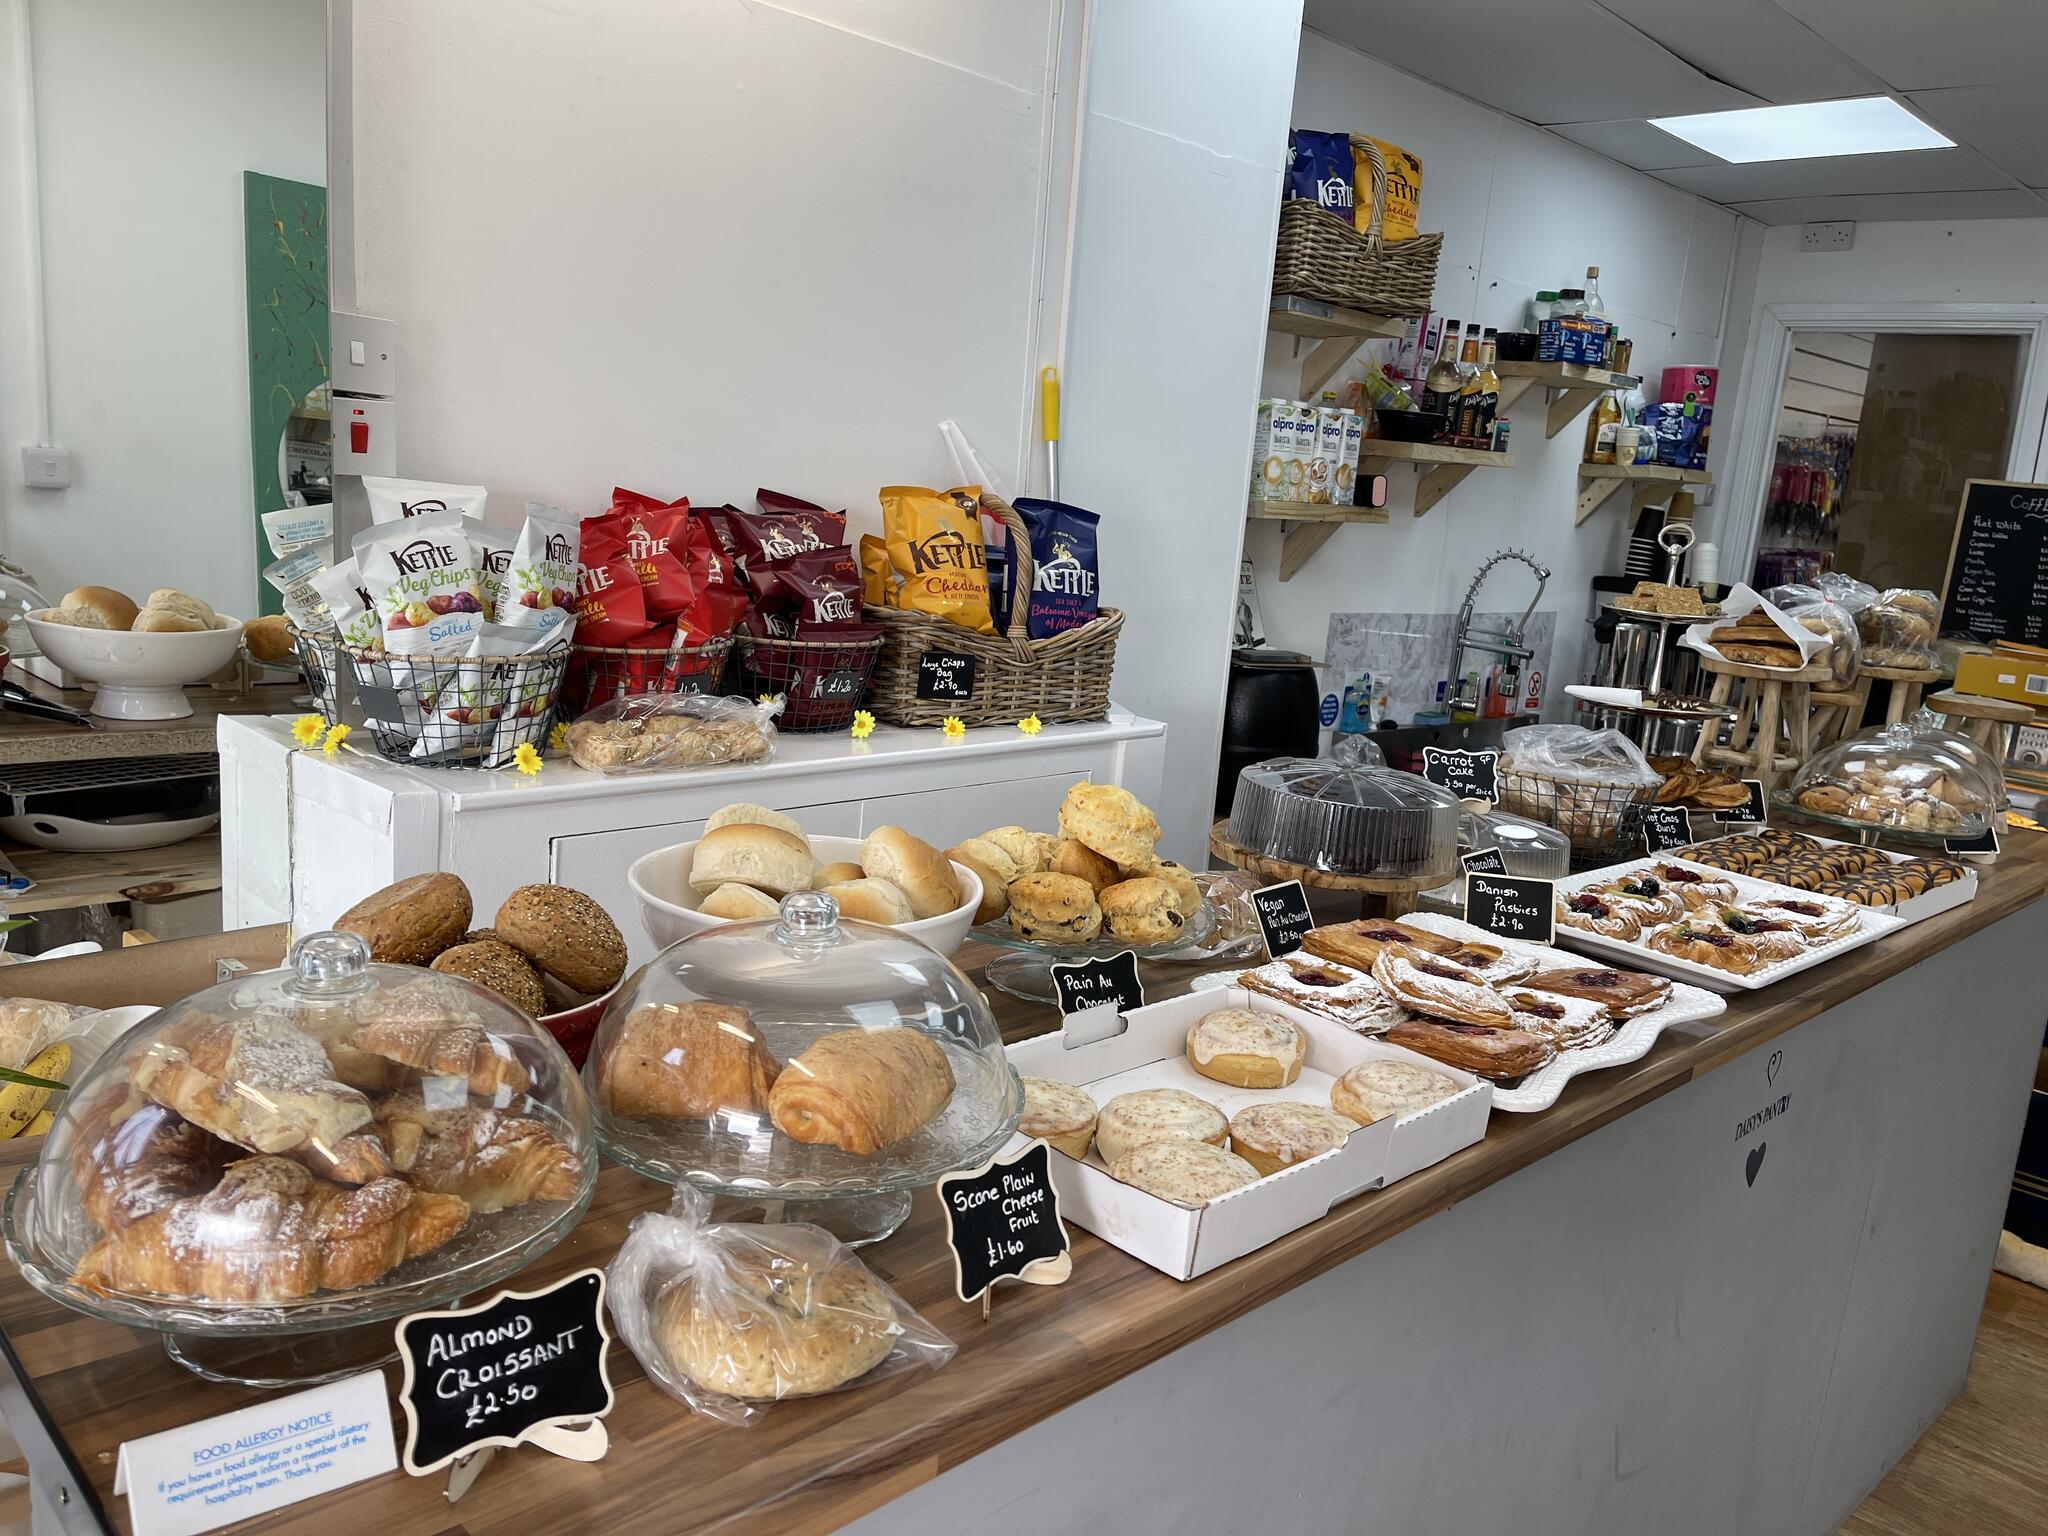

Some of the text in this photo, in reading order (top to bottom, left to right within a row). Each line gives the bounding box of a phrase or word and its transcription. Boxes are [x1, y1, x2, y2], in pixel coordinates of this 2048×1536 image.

[1317, 177, 1354, 208] KETTLE
[1385, 172, 1420, 204] ETTLE
[1273, 417, 1294, 432] alpro
[1295, 420, 1315, 435] alpro
[1323, 423, 1340, 438] alpro
[1346, 427, 1361, 440] alpro
[389, 540, 458, 576] KETTLE
[545, 533, 573, 565] KETTLE
[626, 530, 670, 560] TTLE
[907, 531, 986, 575] KETTLE
[396, 567, 472, 596] Veg Chips
[541, 562, 577, 587] Veg Chips
[925, 577, 988, 594] Cheddar
[1032, 557, 1095, 597] KETTLE
[813, 591, 855, 624] KETTLE
[1031, 604, 1071, 617] Balsamic
[429, 619, 472, 642] Salted
[936, 667, 953, 682] Bag
[941, 658, 966, 669] Crisps
[933, 678, 958, 691] £2.90
[1429, 753, 1492, 767] Carrot GF
[1447, 767, 1475, 777] Cake
[1475, 880, 1519, 898] Danish
[1257, 898, 1285, 917] Vegan
[1494, 896, 1538, 917] Pastries
[1490, 914, 1524, 931] £2.90
[1063, 973, 1113, 991] Pain Au
[953, 1167, 1035, 1212] Scone Plain
[1002, 1188, 1044, 1215] Cheese
[1009, 1207, 1040, 1233] Fruit
[987, 1237, 1024, 1267] £1.60
[426, 1314, 533, 1368] ALMOND
[436, 1324, 584, 1400] CROISSANT
[464, 1383, 538, 1429] £2.50
[193, 1411, 334, 1463] FOOD ALLERGY NOTICE
[166, 1479, 225, 1505] requirement
[227, 1470, 258, 1488] please
[260, 1458, 290, 1474] inform
[301, 1444, 338, 1463] member
[340, 1437, 350, 1450] of
[351, 1433, 367, 1446] the
[167, 1479, 187, 1491] you
[188, 1470, 213, 1484] have
[223, 1459, 247, 1473] food
[249, 1450, 281, 1467] allergy
[282, 1445, 293, 1455] or
[305, 1430, 336, 1449] special
[338, 1421, 370, 1438] dietary
[205, 1484, 254, 1506] hospitality
[256, 1475, 283, 1490] team.
[284, 1464, 313, 1480] Thank
